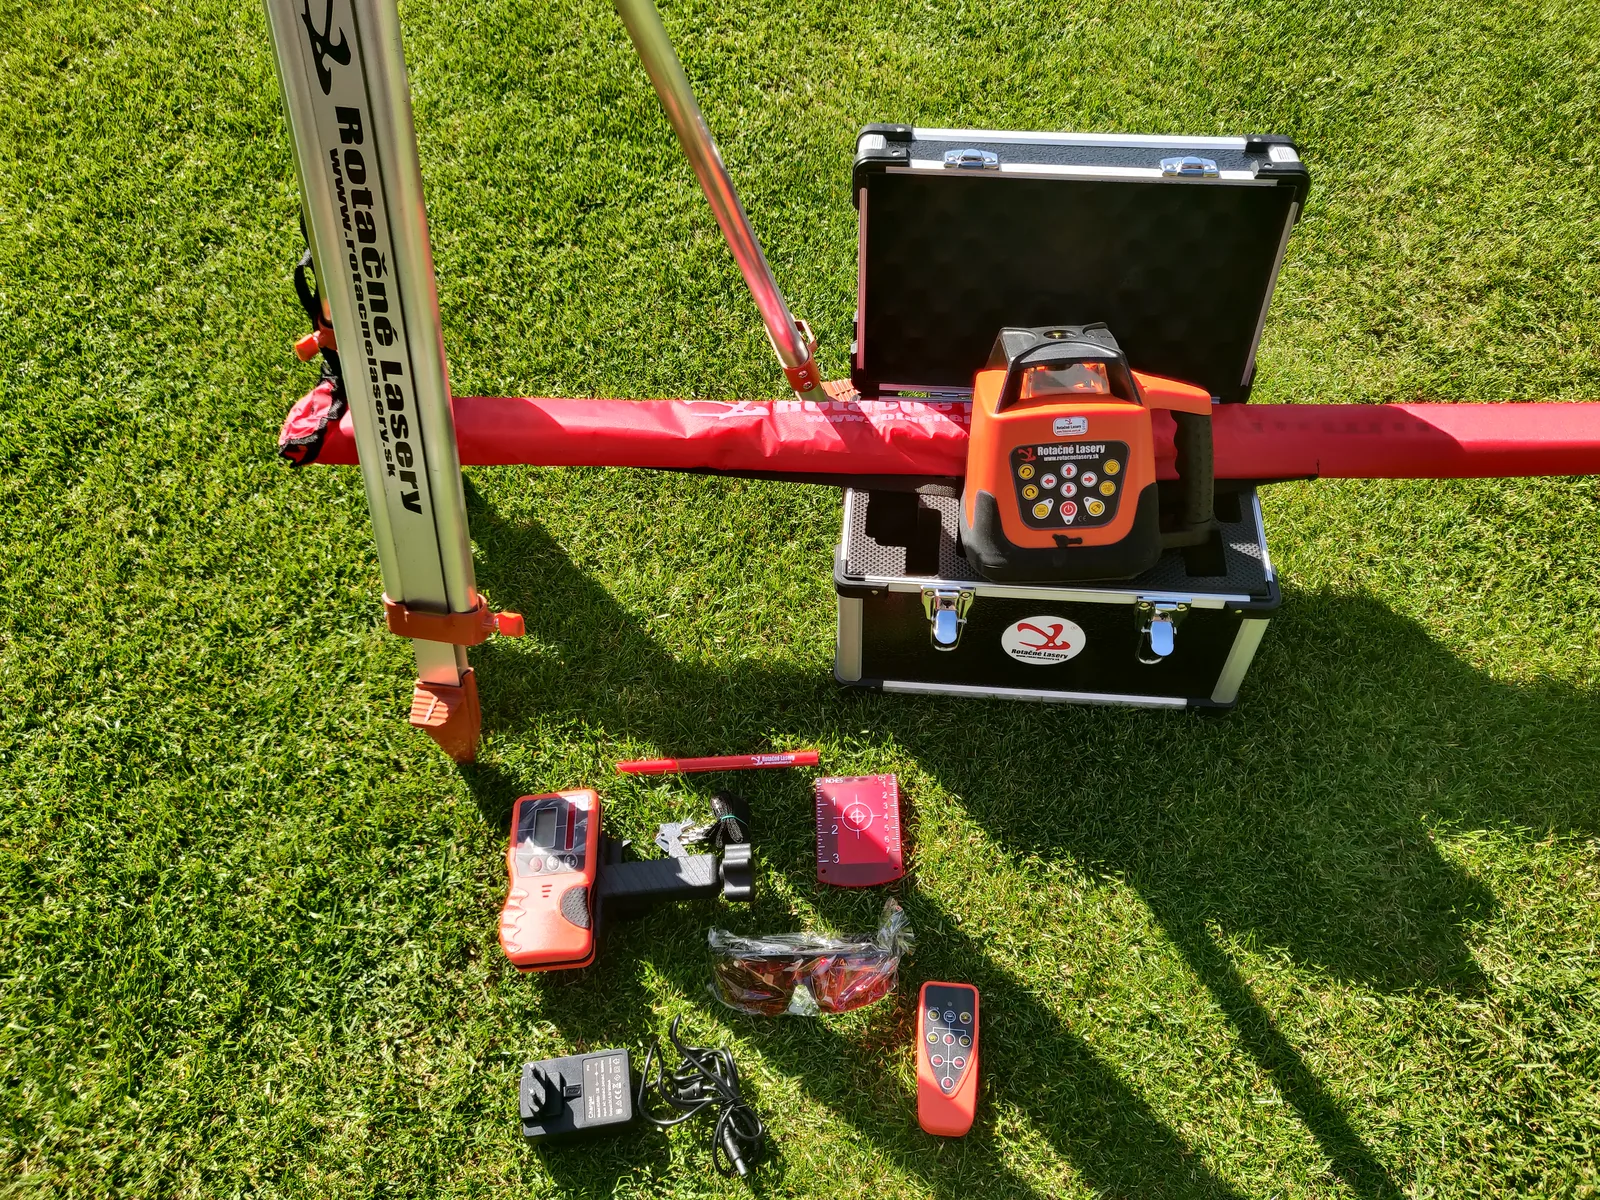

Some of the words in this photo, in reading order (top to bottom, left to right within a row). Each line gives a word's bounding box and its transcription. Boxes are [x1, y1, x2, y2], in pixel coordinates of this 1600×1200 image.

[329, 148, 397, 478] www.rotacnelasery.sk
[335, 105, 399, 347] Rotačné
[380, 360, 423, 516] Lasery
[1037, 445, 1074, 456] Rotačné
[1076, 444, 1105, 454] Lasery
[831, 797, 836, 806] 1
[831, 824, 838, 835] 2
[832, 853, 840, 864] 3
